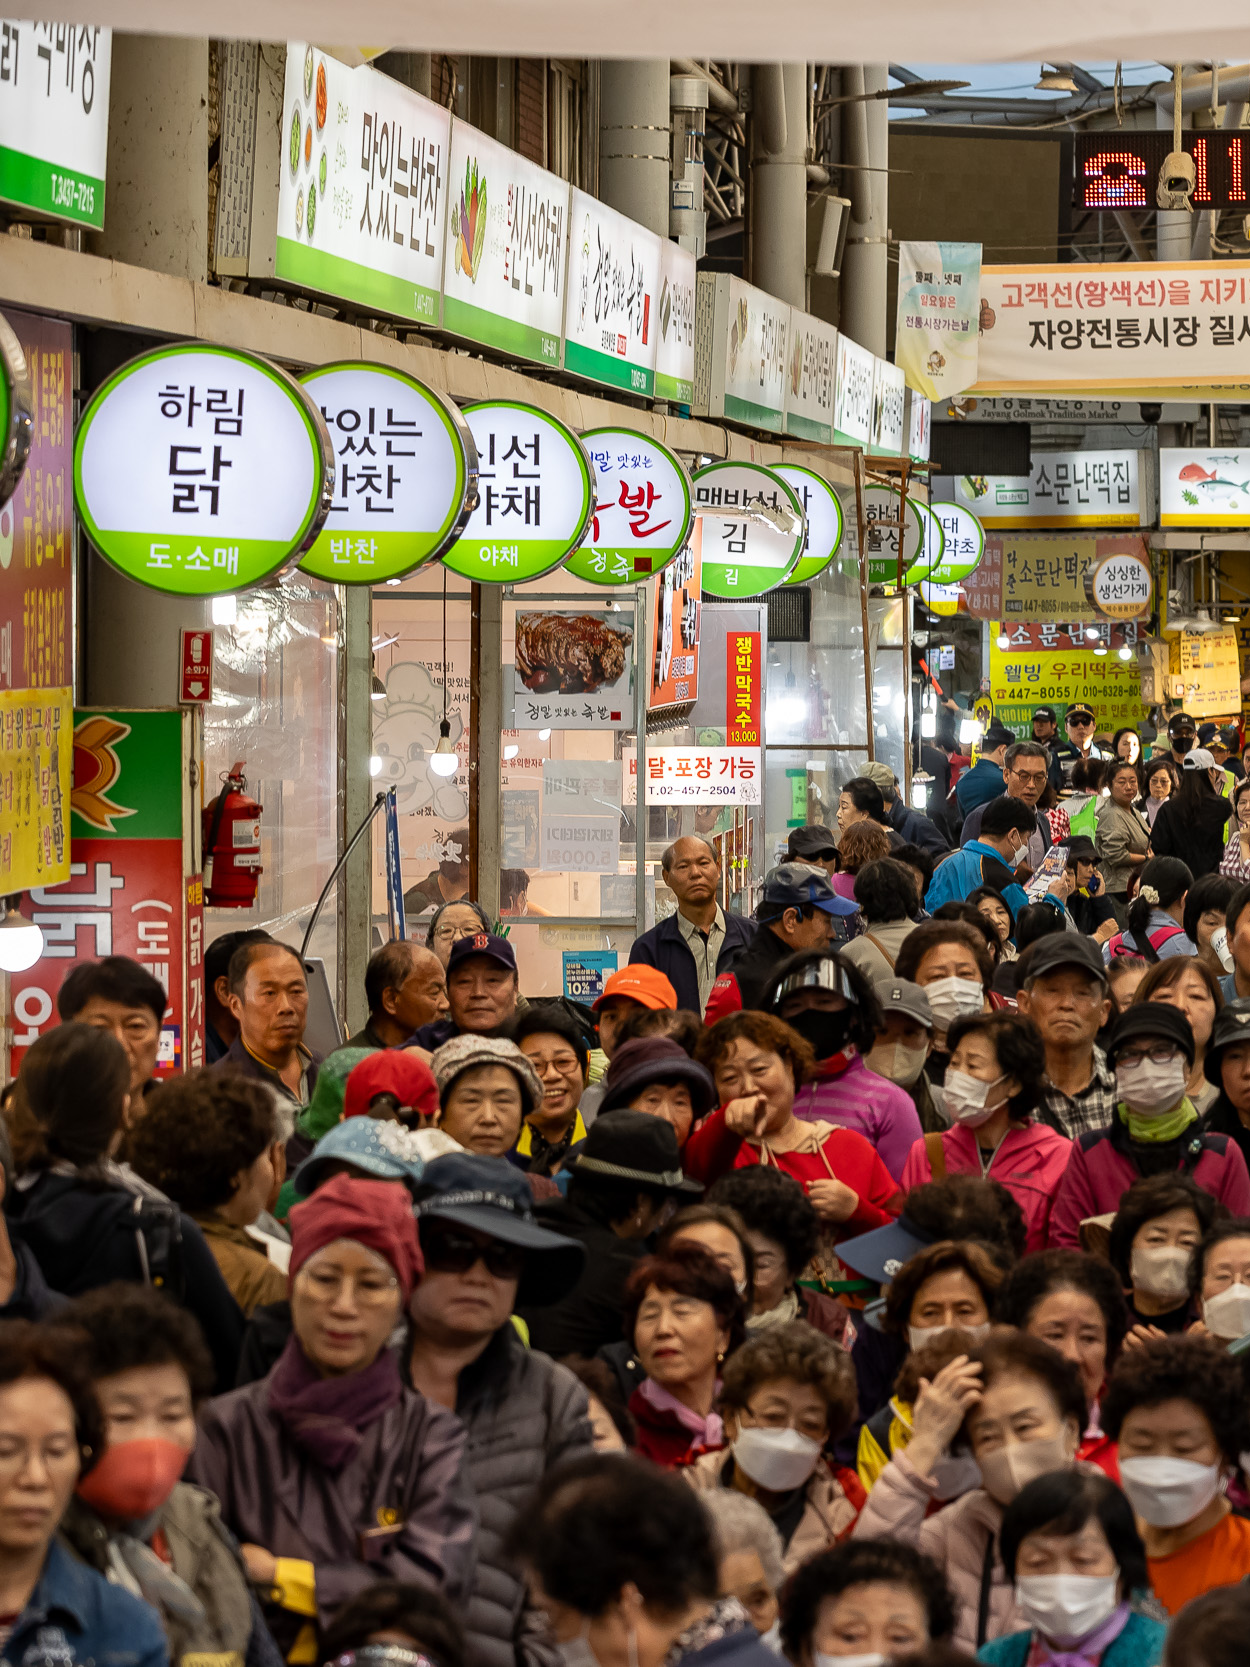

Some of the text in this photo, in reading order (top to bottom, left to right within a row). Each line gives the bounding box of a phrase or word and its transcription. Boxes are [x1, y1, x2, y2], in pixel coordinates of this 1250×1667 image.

[920, 294, 956, 308] 일요일은
[1001, 279, 1191, 309] 고객선(황색선)을
[905, 315, 969, 331] 전통시장가는날
[1029, 315, 1200, 350] 자양전통시장
[158, 384, 245, 437] 하림
[982, 408, 1118, 420] Jayang Golmok Tradition Market
[323, 406, 423, 458] 있는
[617, 454, 653, 470] 맛있는
[168, 444, 233, 516] 닭
[1035, 461, 1130, 504] 소문난떡집
[722, 514, 748, 553] 김
[146, 543, 240, 576] 도·소매
[330, 538, 378, 565] 반찬
[479, 544, 518, 567] 야채
[725, 568, 739, 586] 김
[1105, 565, 1142, 581] 싱싱한
[1099, 583, 1148, 600] 생선가게
[185, 665, 209, 675] 소화기
[1004, 663, 1041, 682] 웰빙
[735, 636, 752, 729] 쟁반막국수
[1009, 687, 1070, 700] 447-8055
[1083, 685, 1141, 698] 010-6328-805
[525, 702, 610, 721] 정말 맛있는 족발
[730, 731, 757, 742] 13,000
[719, 756, 755, 779] 가능
